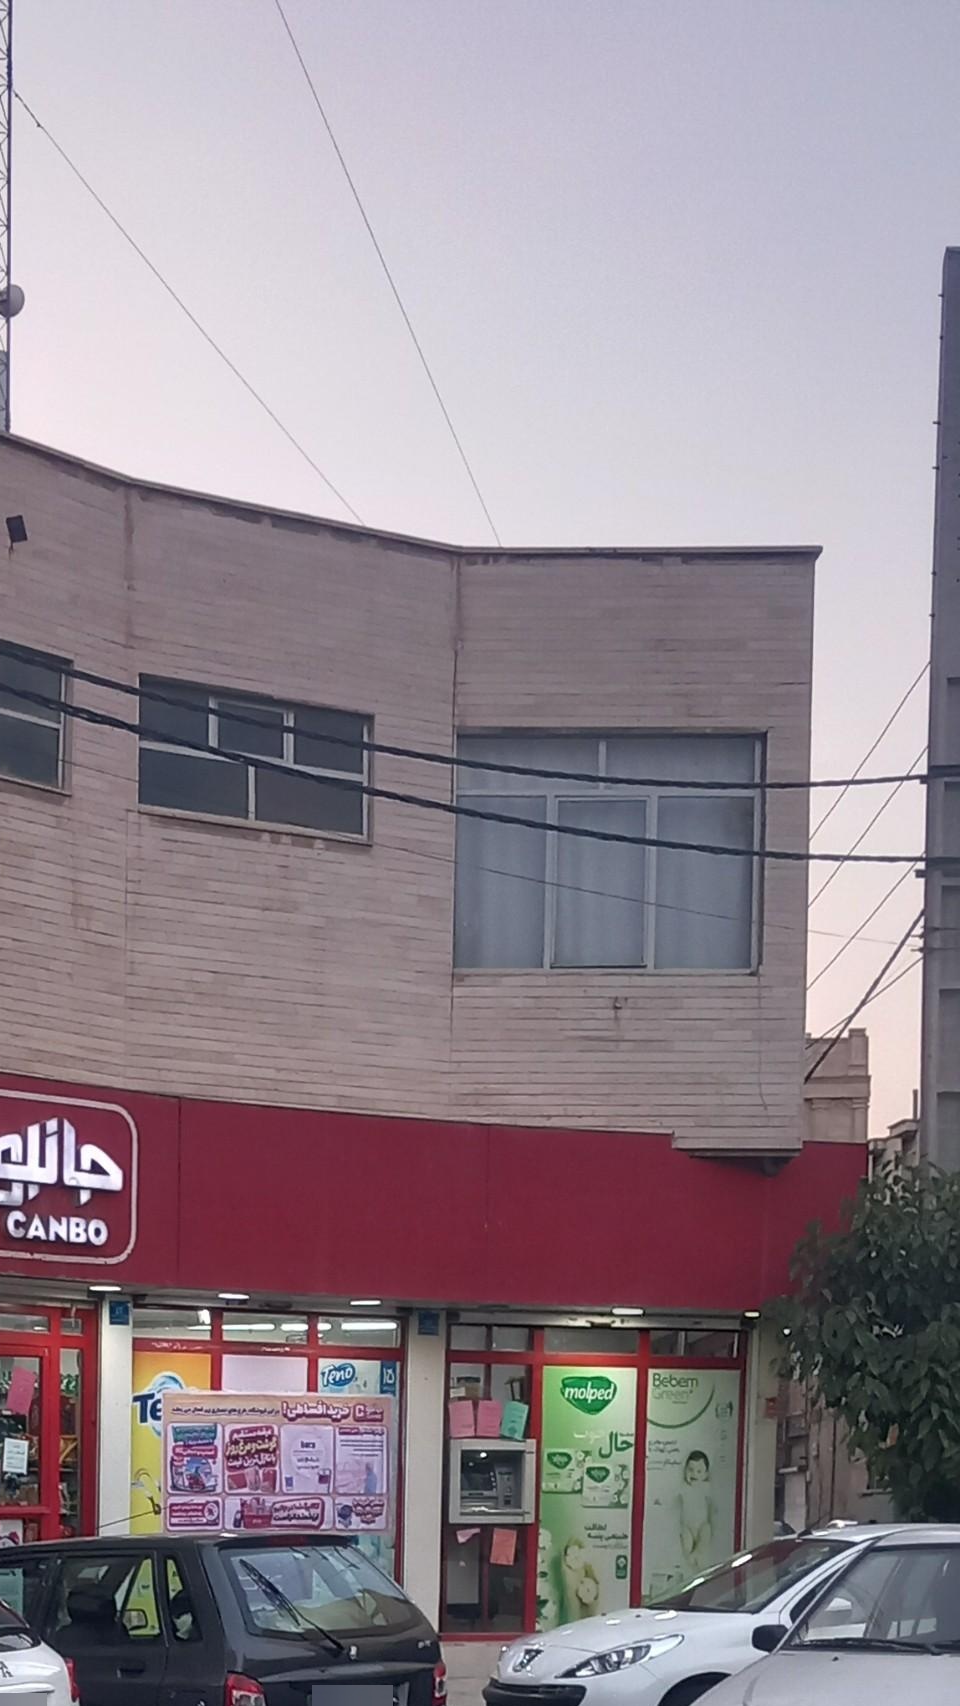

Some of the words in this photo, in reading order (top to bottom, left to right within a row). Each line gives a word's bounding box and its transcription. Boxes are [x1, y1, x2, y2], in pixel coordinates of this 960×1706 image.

[5, 1210, 109, 1247] CANBO
[321, 1364, 354, 1387] Teno
[652, 1373, 699, 1388] Bebem
[564, 1381, 614, 1404] molped
[132, 1393, 162, 1424] Te
[598, 1431, 634, 1459] حال
